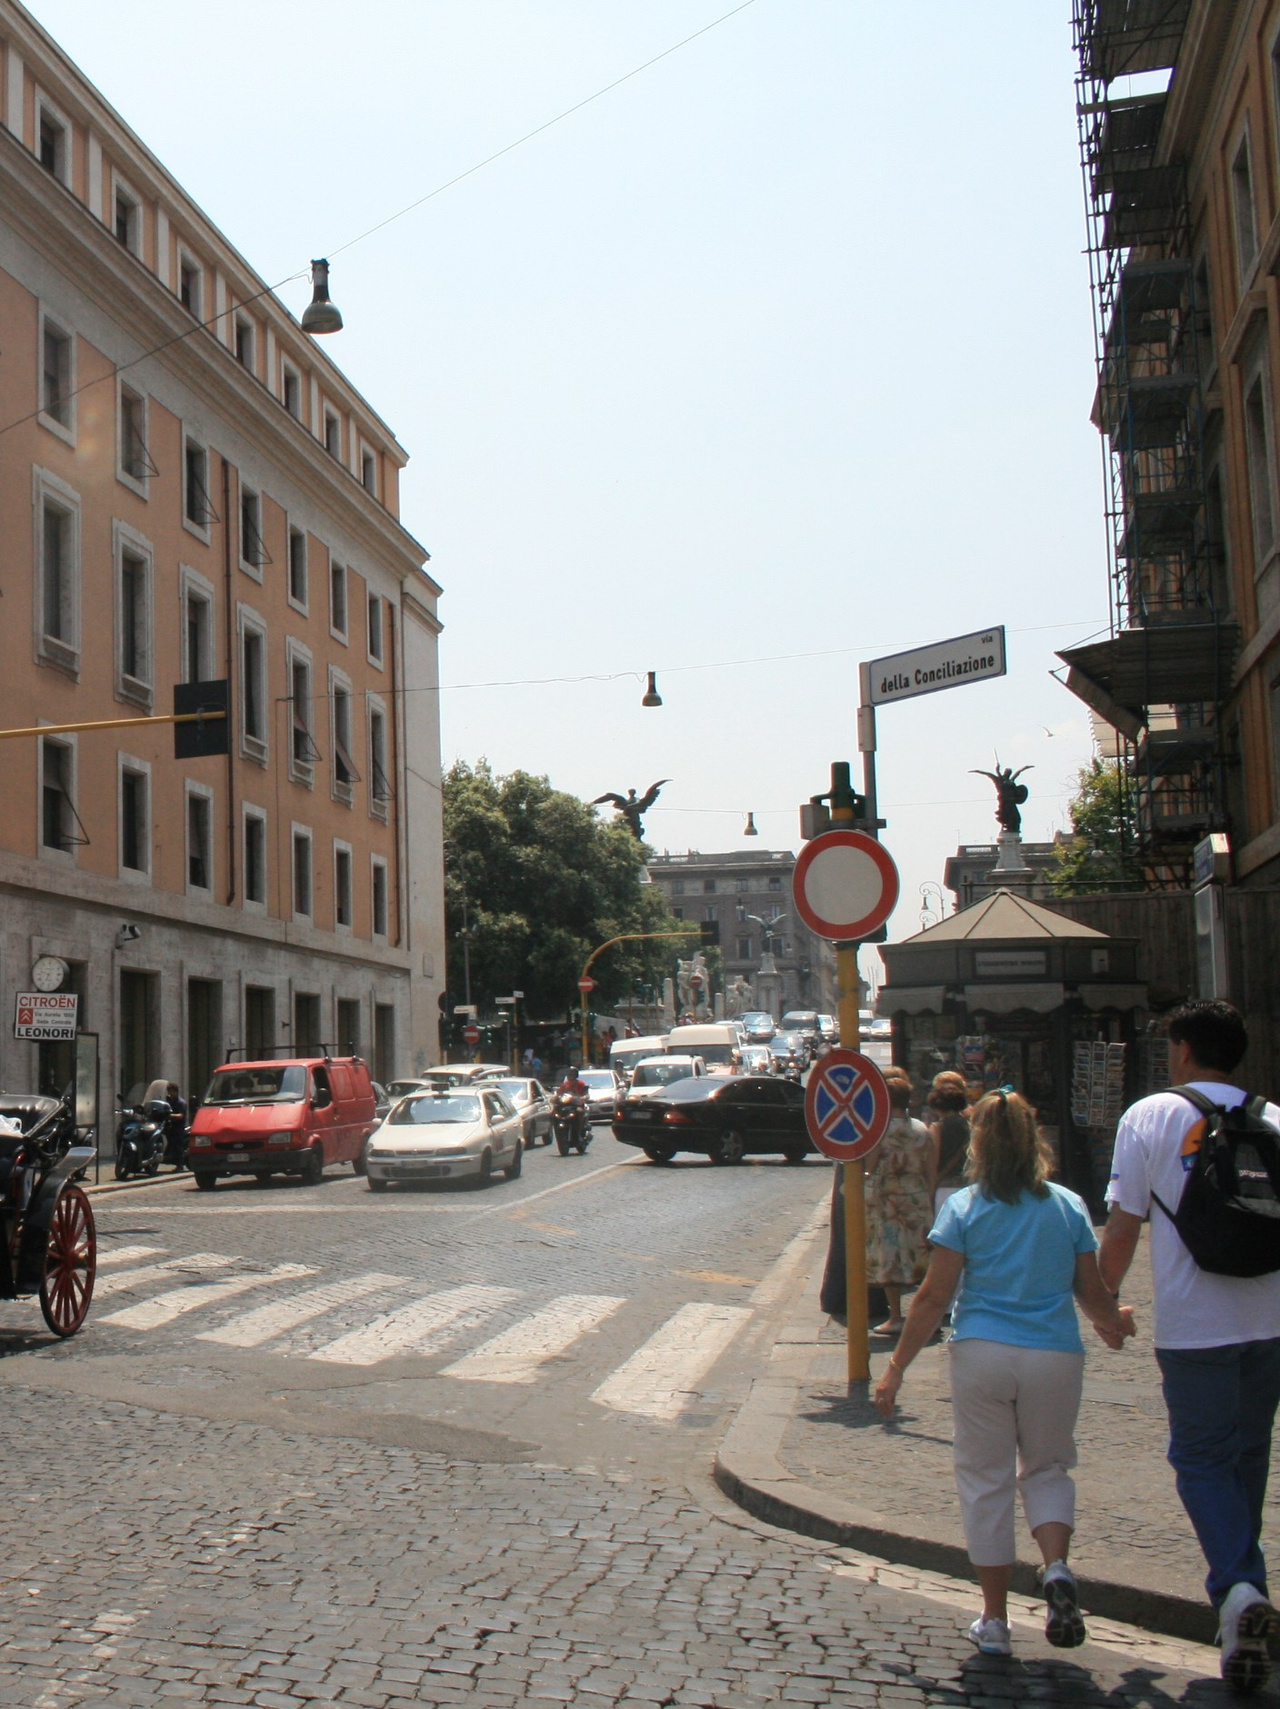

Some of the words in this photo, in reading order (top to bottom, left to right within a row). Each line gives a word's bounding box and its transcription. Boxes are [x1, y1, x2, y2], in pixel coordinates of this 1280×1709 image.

[981, 635, 993, 644] via
[881, 673, 910, 694] della
[914, 654, 995, 686] Conciliazione
[19, 994, 76, 1008] CITROËN
[17, 1027, 74, 1039] LEONORI
